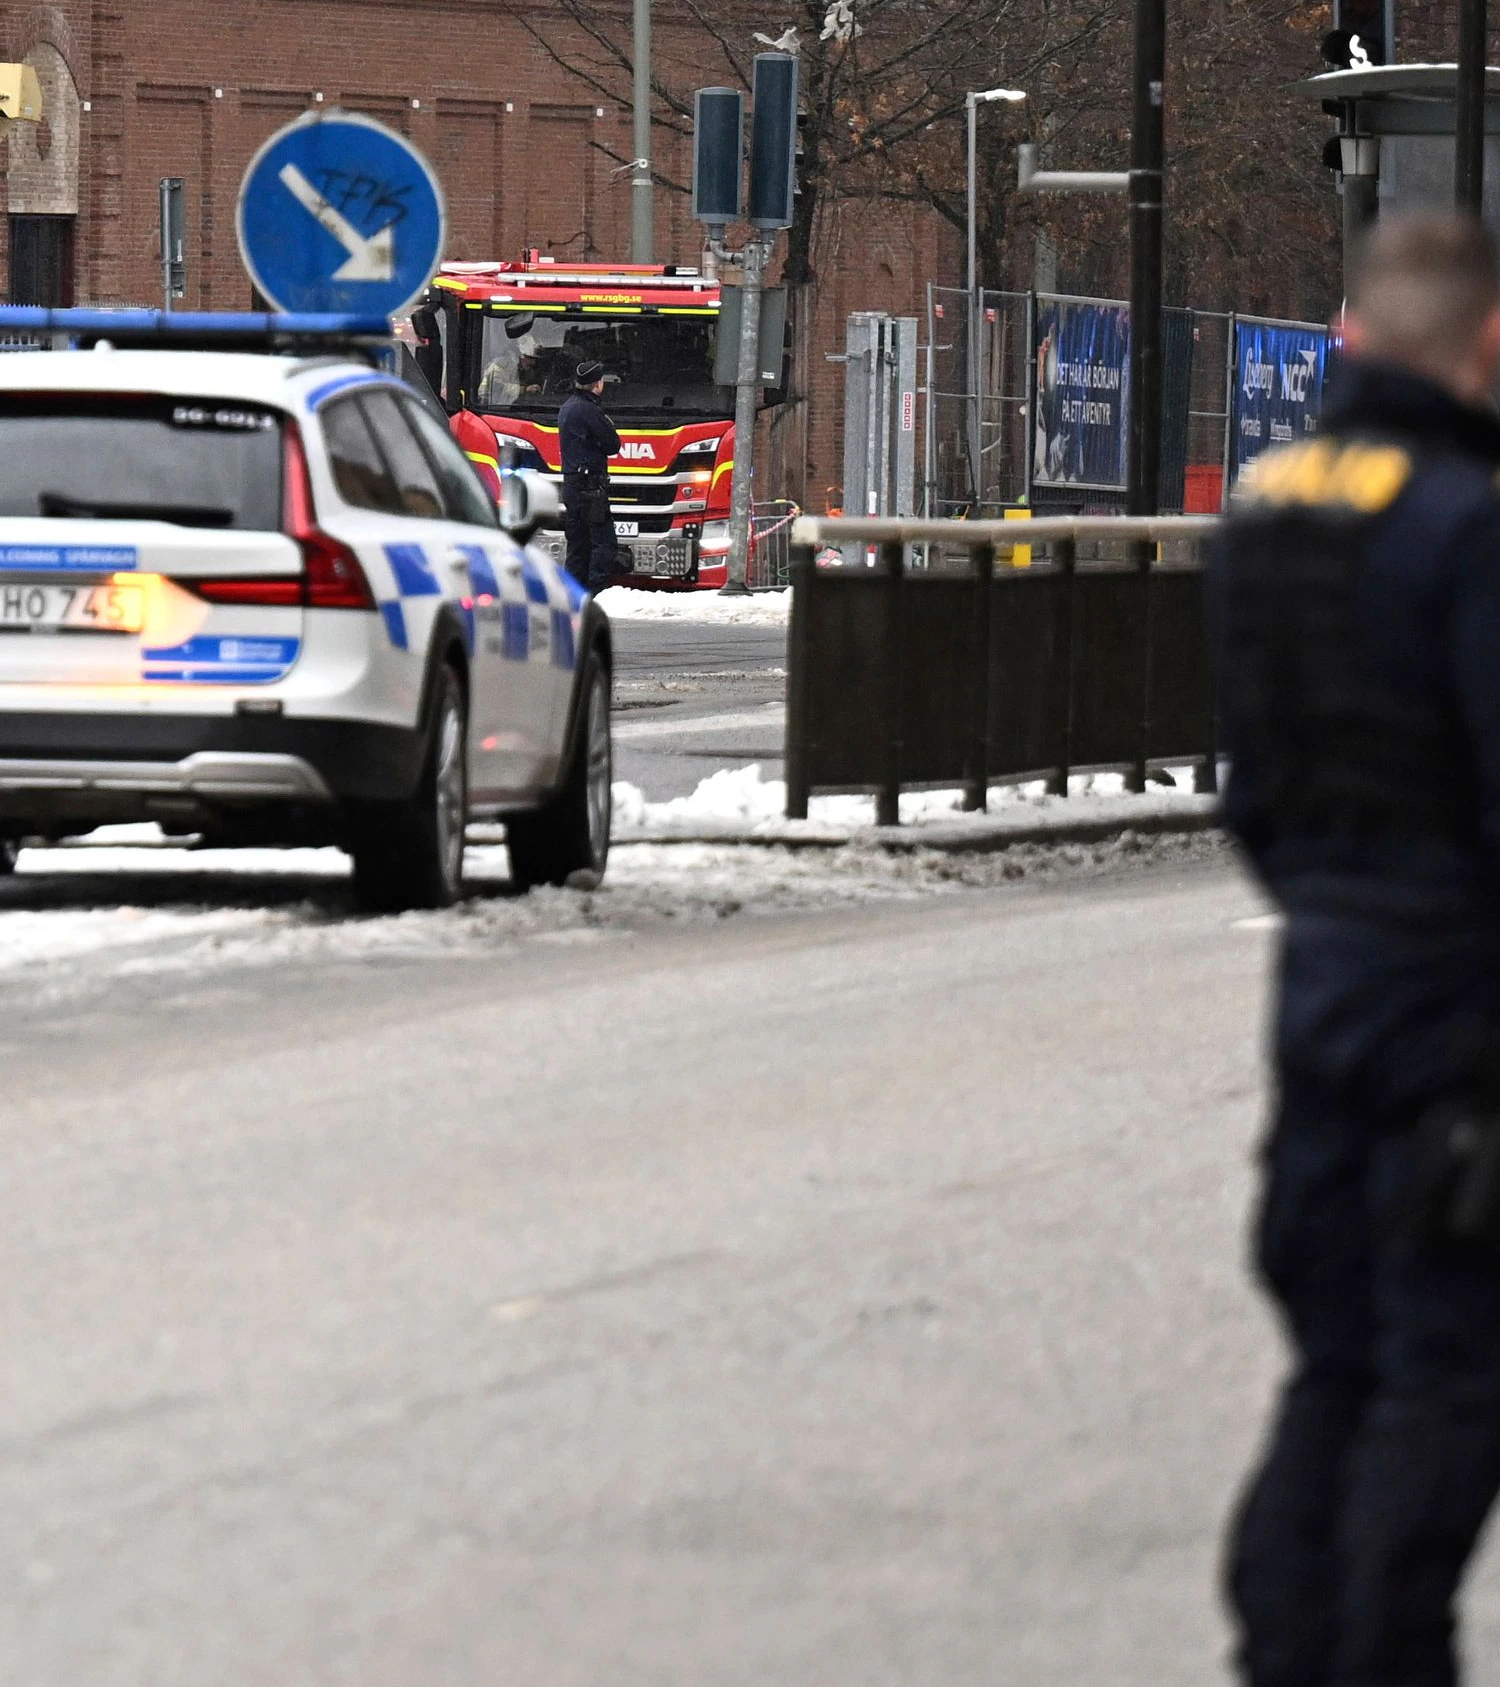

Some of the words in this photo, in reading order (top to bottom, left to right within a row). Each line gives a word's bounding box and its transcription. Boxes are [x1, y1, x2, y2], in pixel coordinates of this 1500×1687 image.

[580, 293, 642, 303] www.rsgbg.se
[1281, 363, 1307, 402] NCC
[618, 442, 656, 460] NIA
